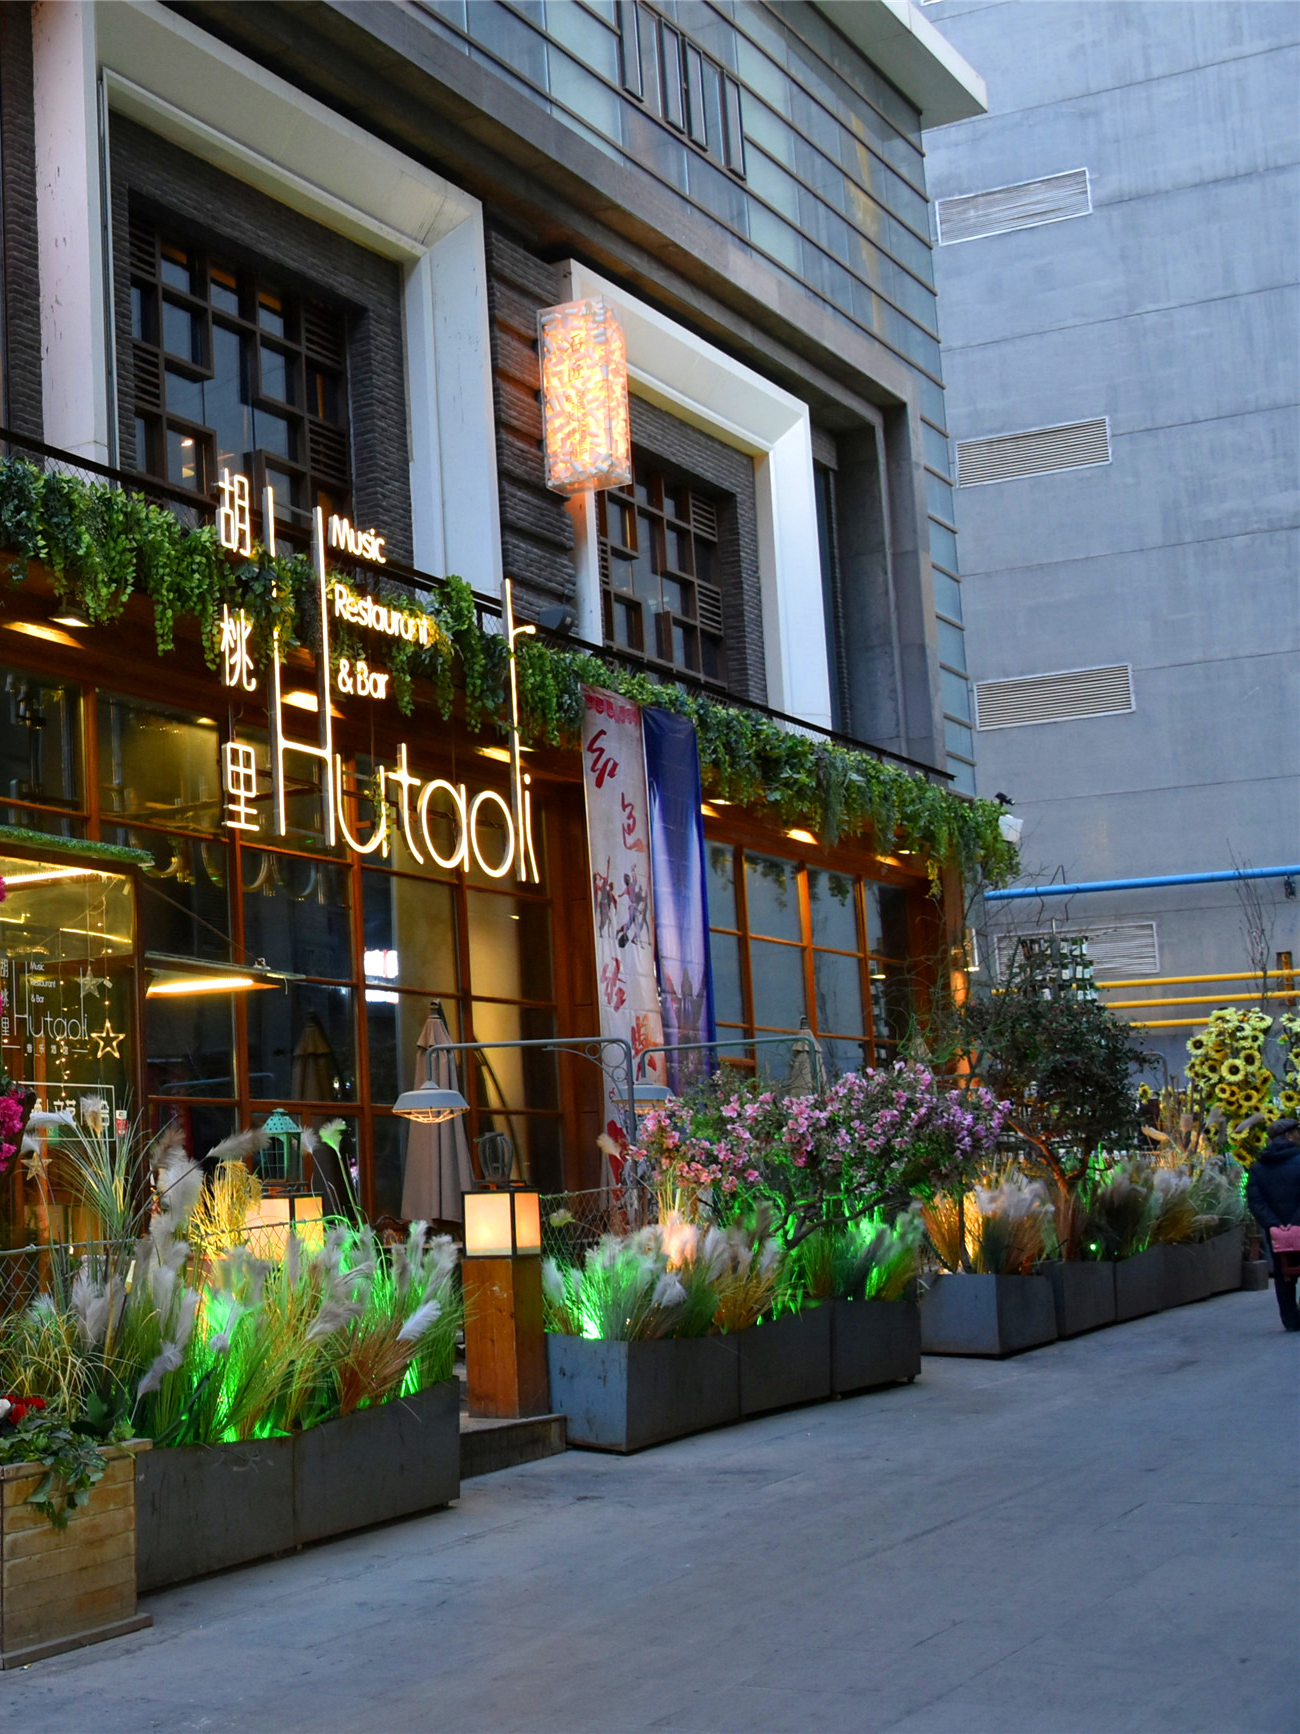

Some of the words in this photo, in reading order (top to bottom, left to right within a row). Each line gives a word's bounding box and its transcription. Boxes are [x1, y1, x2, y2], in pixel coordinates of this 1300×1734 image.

[328, 514, 387, 564] Music
[216, 467, 260, 832] 胡桃里
[337, 658, 353, 694] &
[356, 660, 389, 701] Bar
[263, 486, 539, 884] Hutaoli
[30, 961, 45, 971] Music
[12, 960, 88, 1041] Hutaoli
